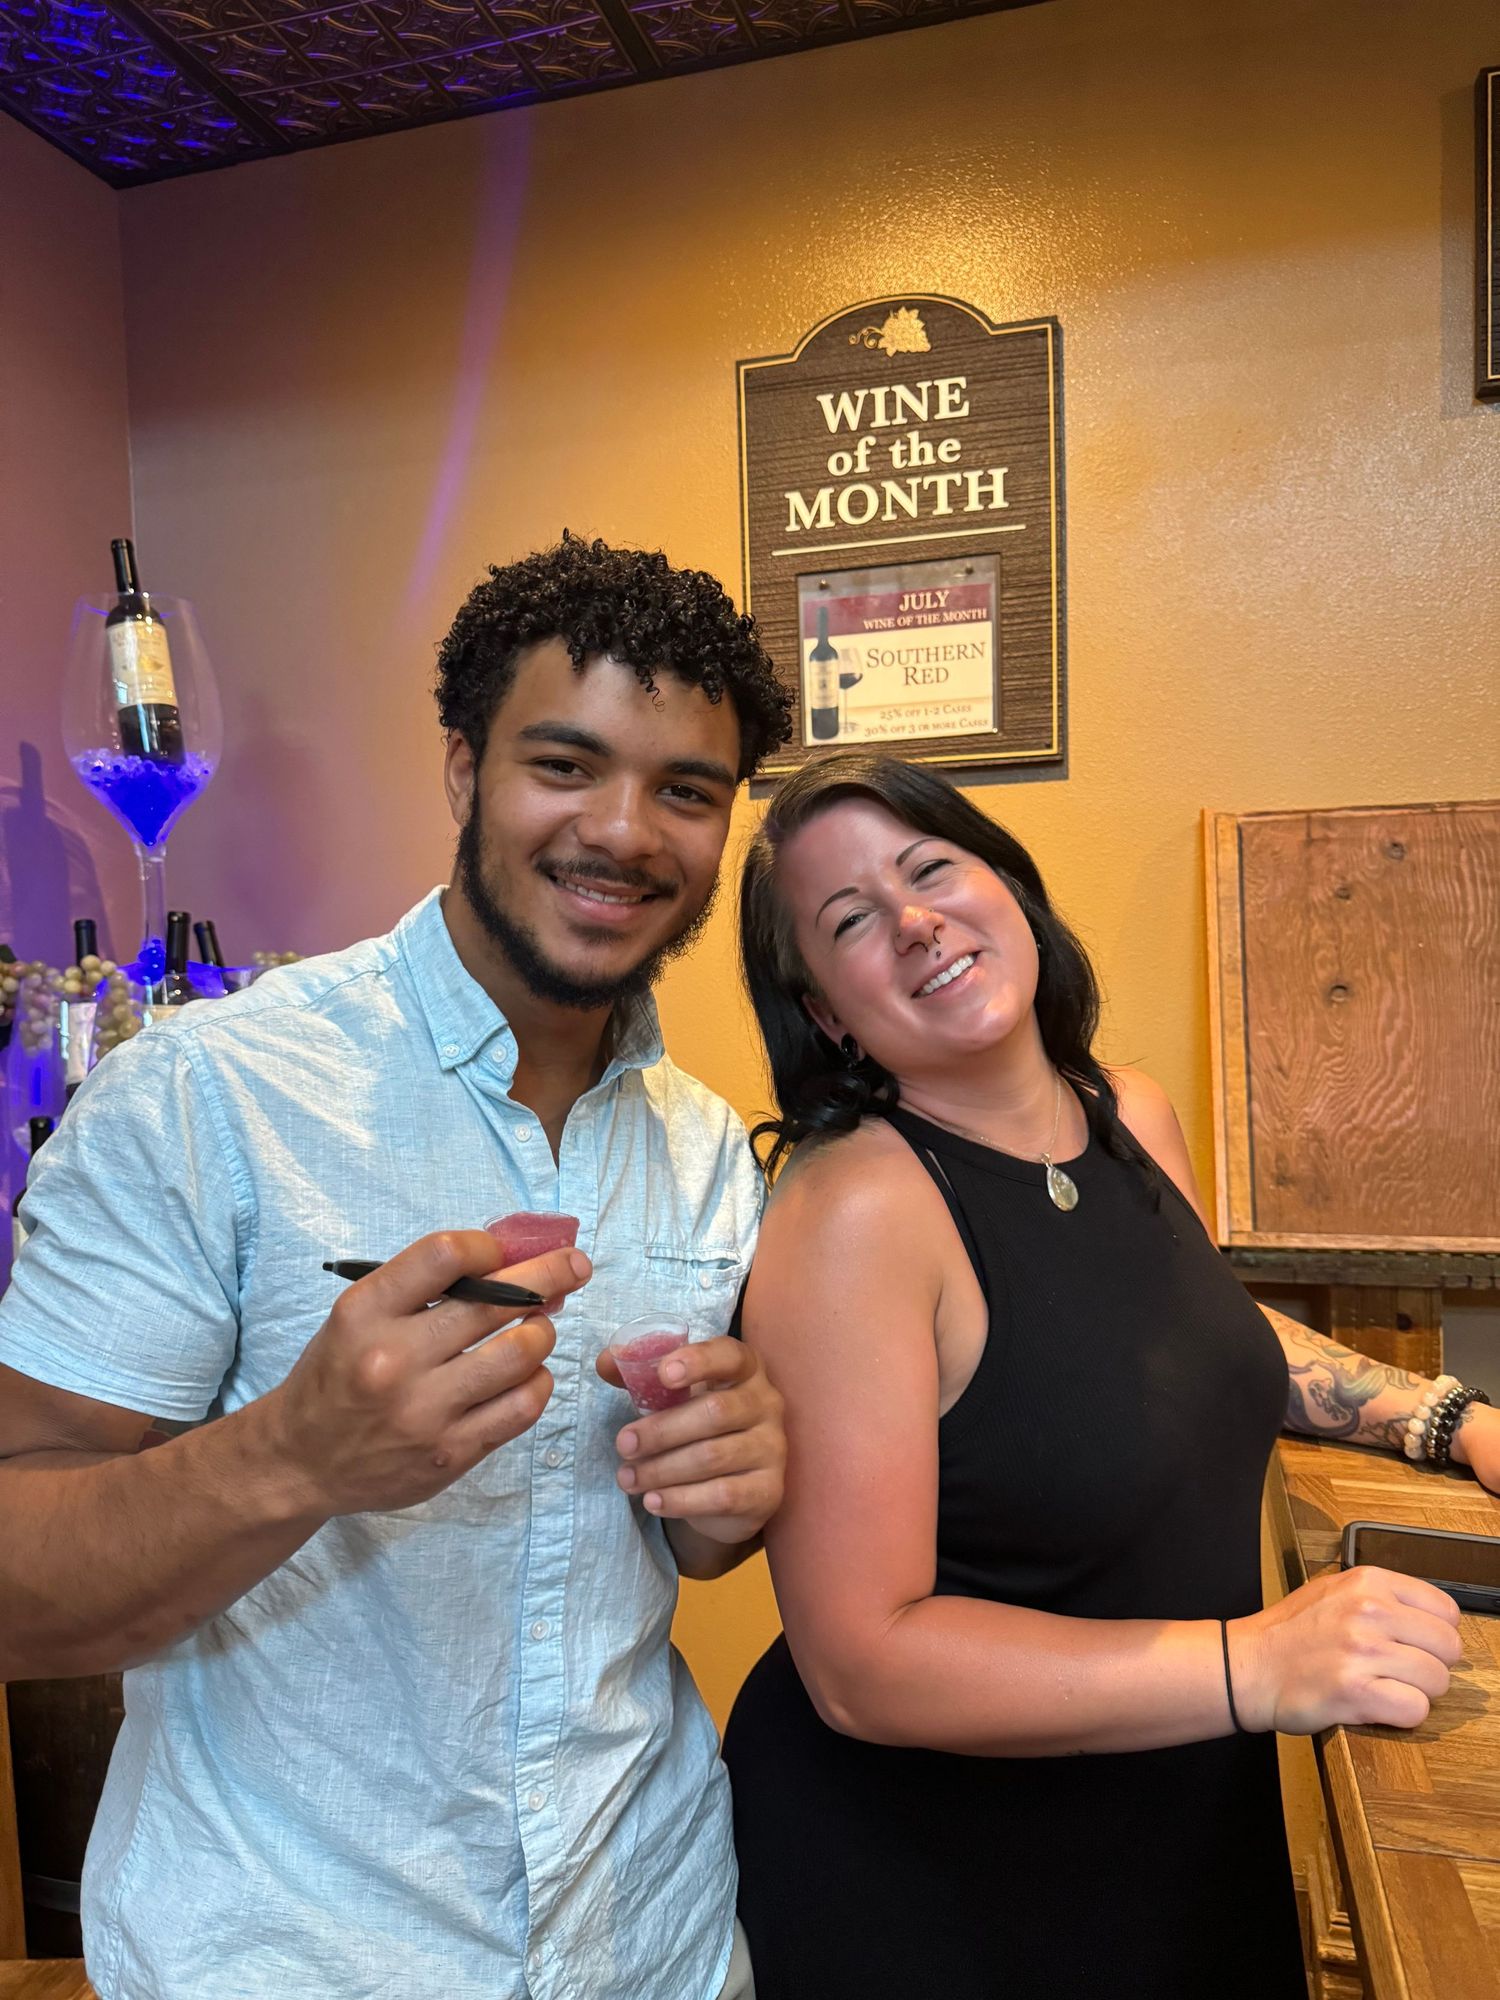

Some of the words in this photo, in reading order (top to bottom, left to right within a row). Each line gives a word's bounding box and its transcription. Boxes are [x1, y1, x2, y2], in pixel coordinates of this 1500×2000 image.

[816, 376, 970, 434] WINE
[827, 435, 877, 476] of
[889, 430, 962, 470] the
[784, 467, 1010, 532] MONTH
[899, 589, 950, 612] JULY
[863, 616, 895, 630] WINE
[896, 615, 913, 627] OF
[914, 613, 941, 625] THE
[942, 608, 987, 623] MONTH
[866, 641, 987, 668] SOUTHERN
[903, 666, 949, 686] RED
[880, 708, 902, 721] 25%
[864, 724, 888, 737] 30%
[908, 724, 916, 735] 3
